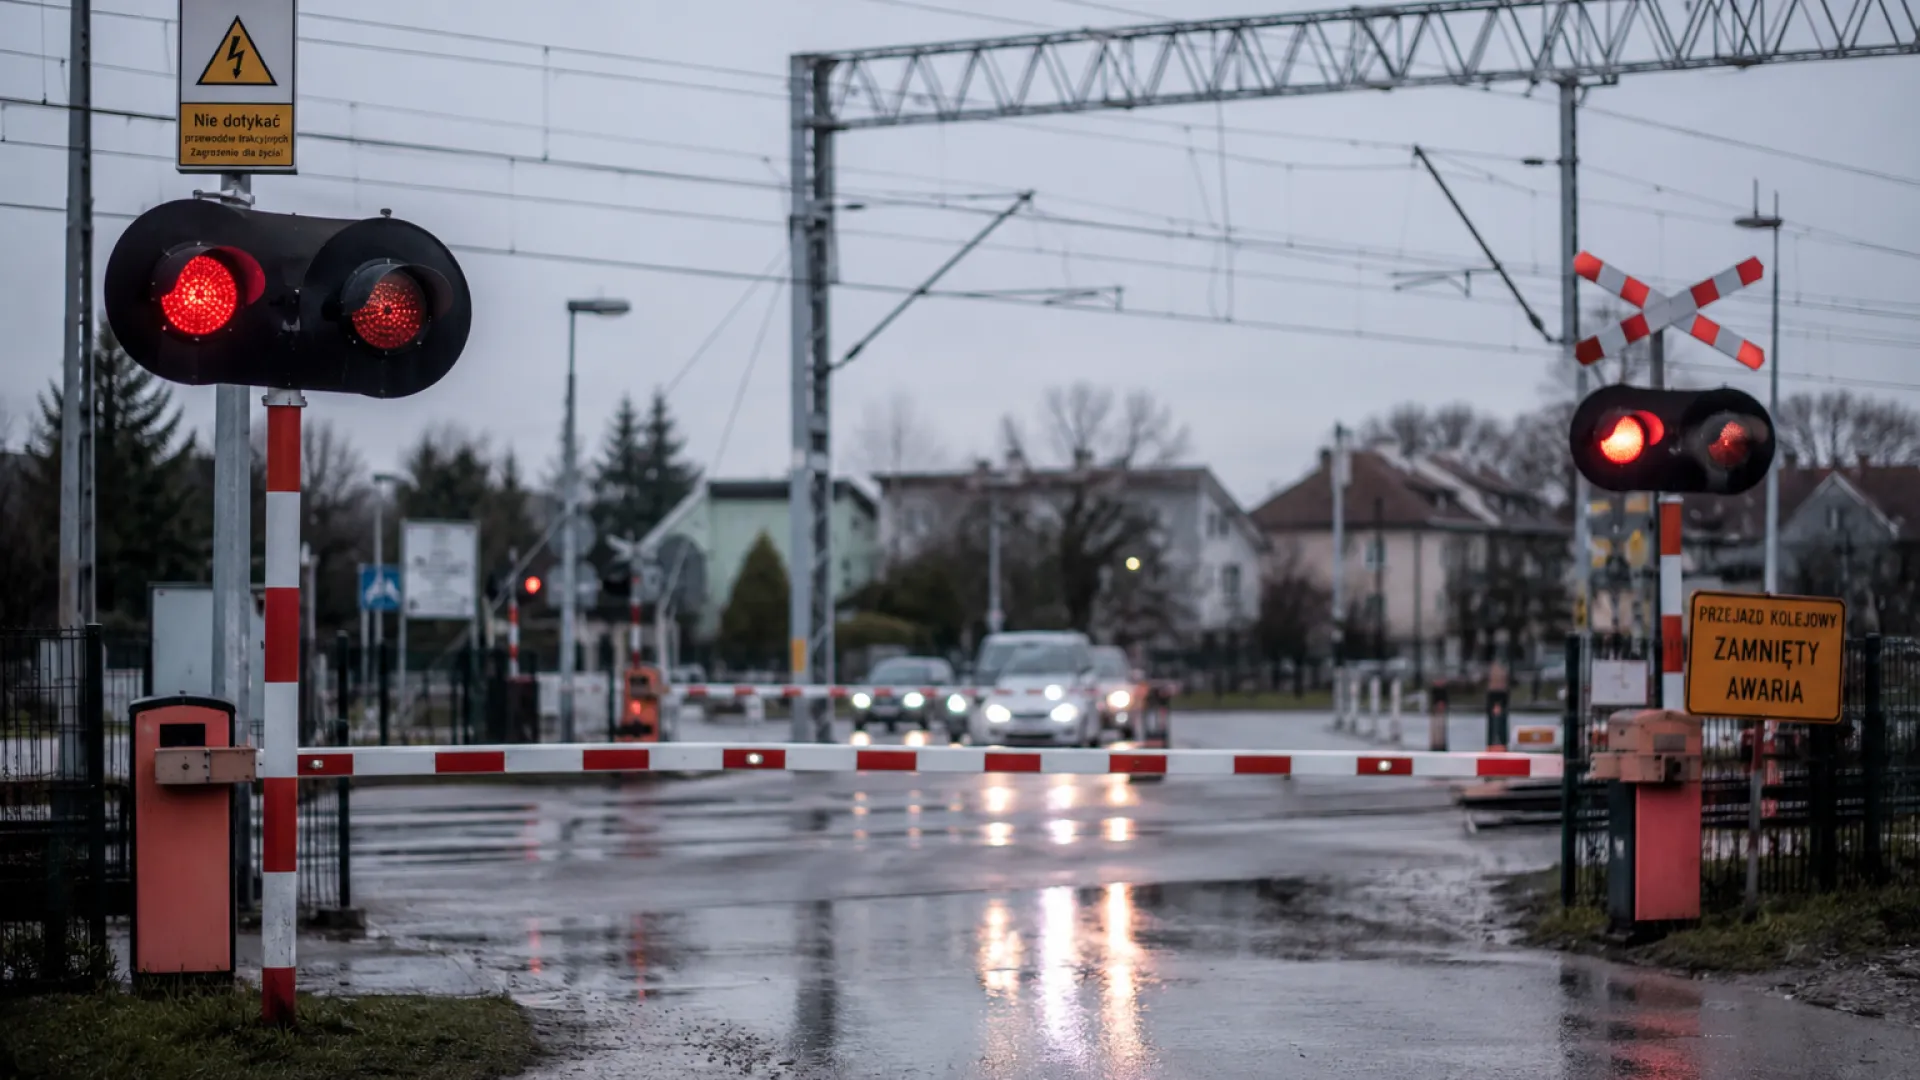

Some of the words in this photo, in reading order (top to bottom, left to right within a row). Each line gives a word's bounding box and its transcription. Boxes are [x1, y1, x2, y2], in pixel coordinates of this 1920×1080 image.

[194, 113, 218, 127] Nie
[223, 113, 281, 130] dotykać
[242, 148, 256, 157] dla
[1699, 605, 1764, 625] PRZEJAZD
[1770, 609, 1838, 629] KOLEJOWY
[1713, 636, 1820, 671] ZAMNIĘTY
[1726, 676, 1804, 704] AWARIA
